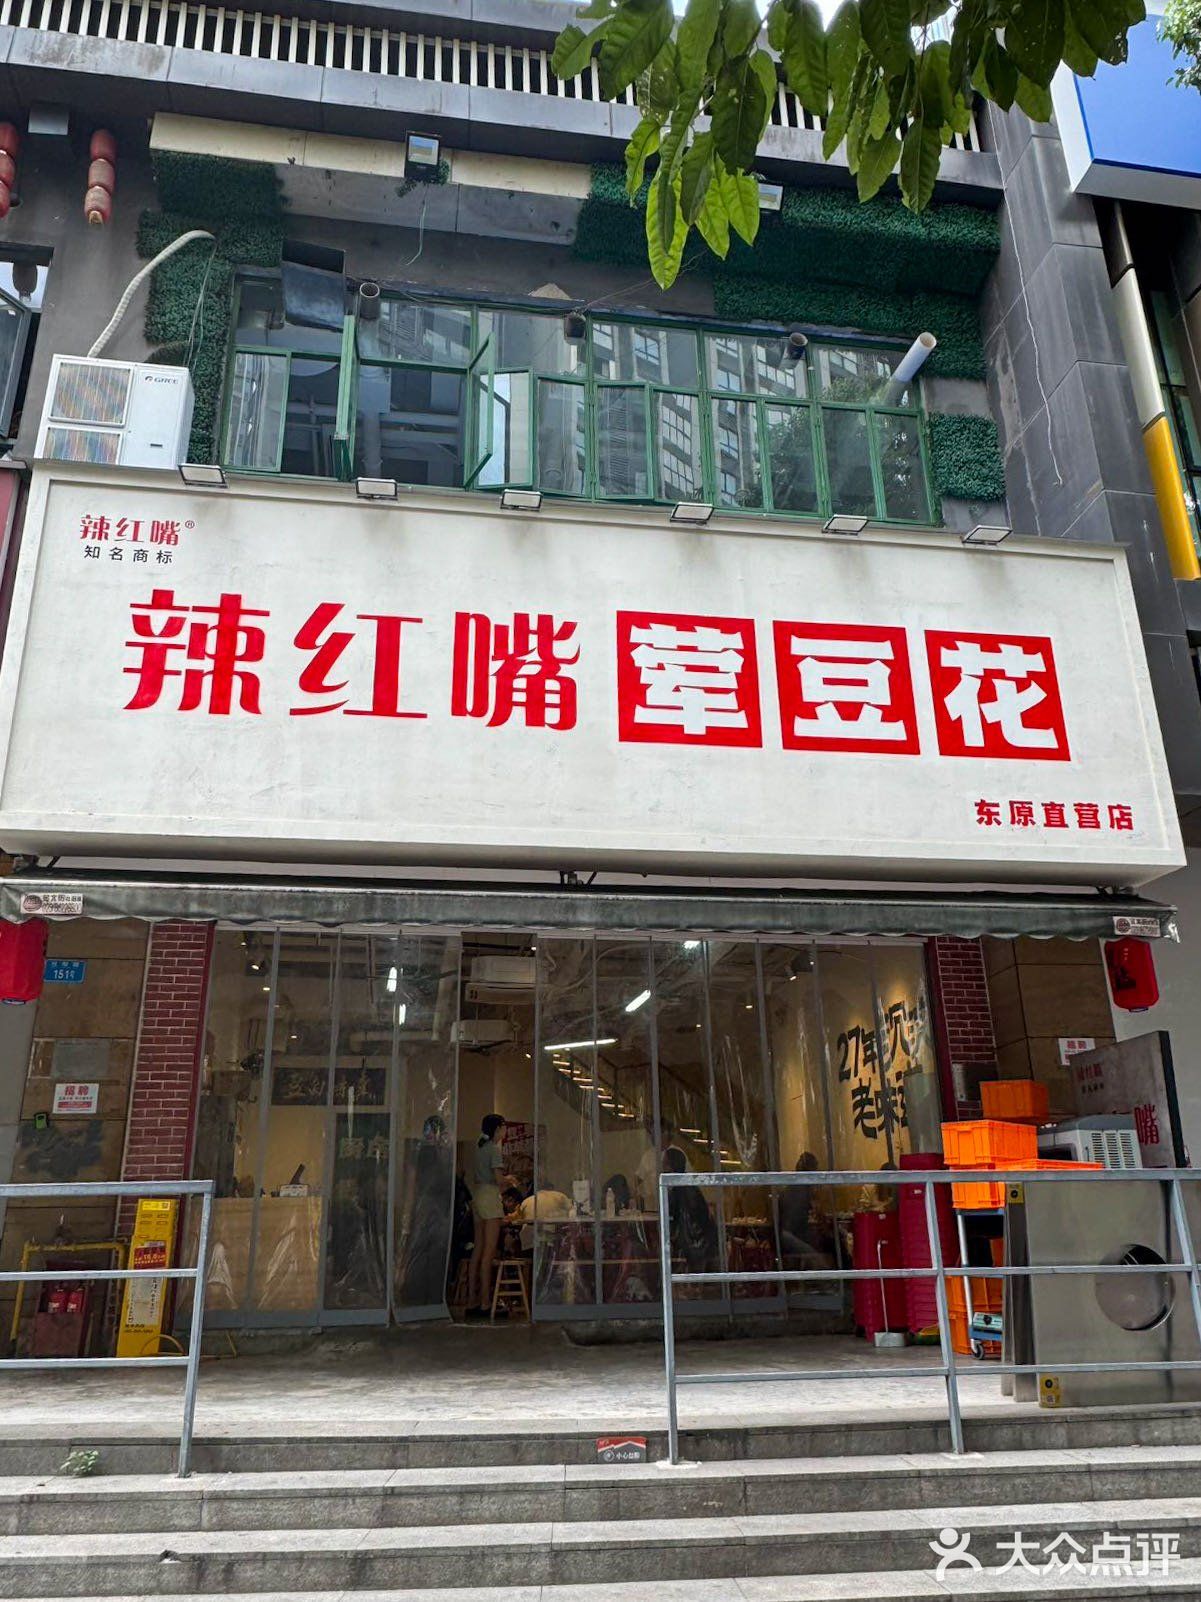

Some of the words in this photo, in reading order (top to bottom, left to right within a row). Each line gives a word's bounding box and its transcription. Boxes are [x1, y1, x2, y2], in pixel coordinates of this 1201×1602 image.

[84, 545, 173, 564] 知名商标
[974, 798, 1135, 831] 东原直营店
